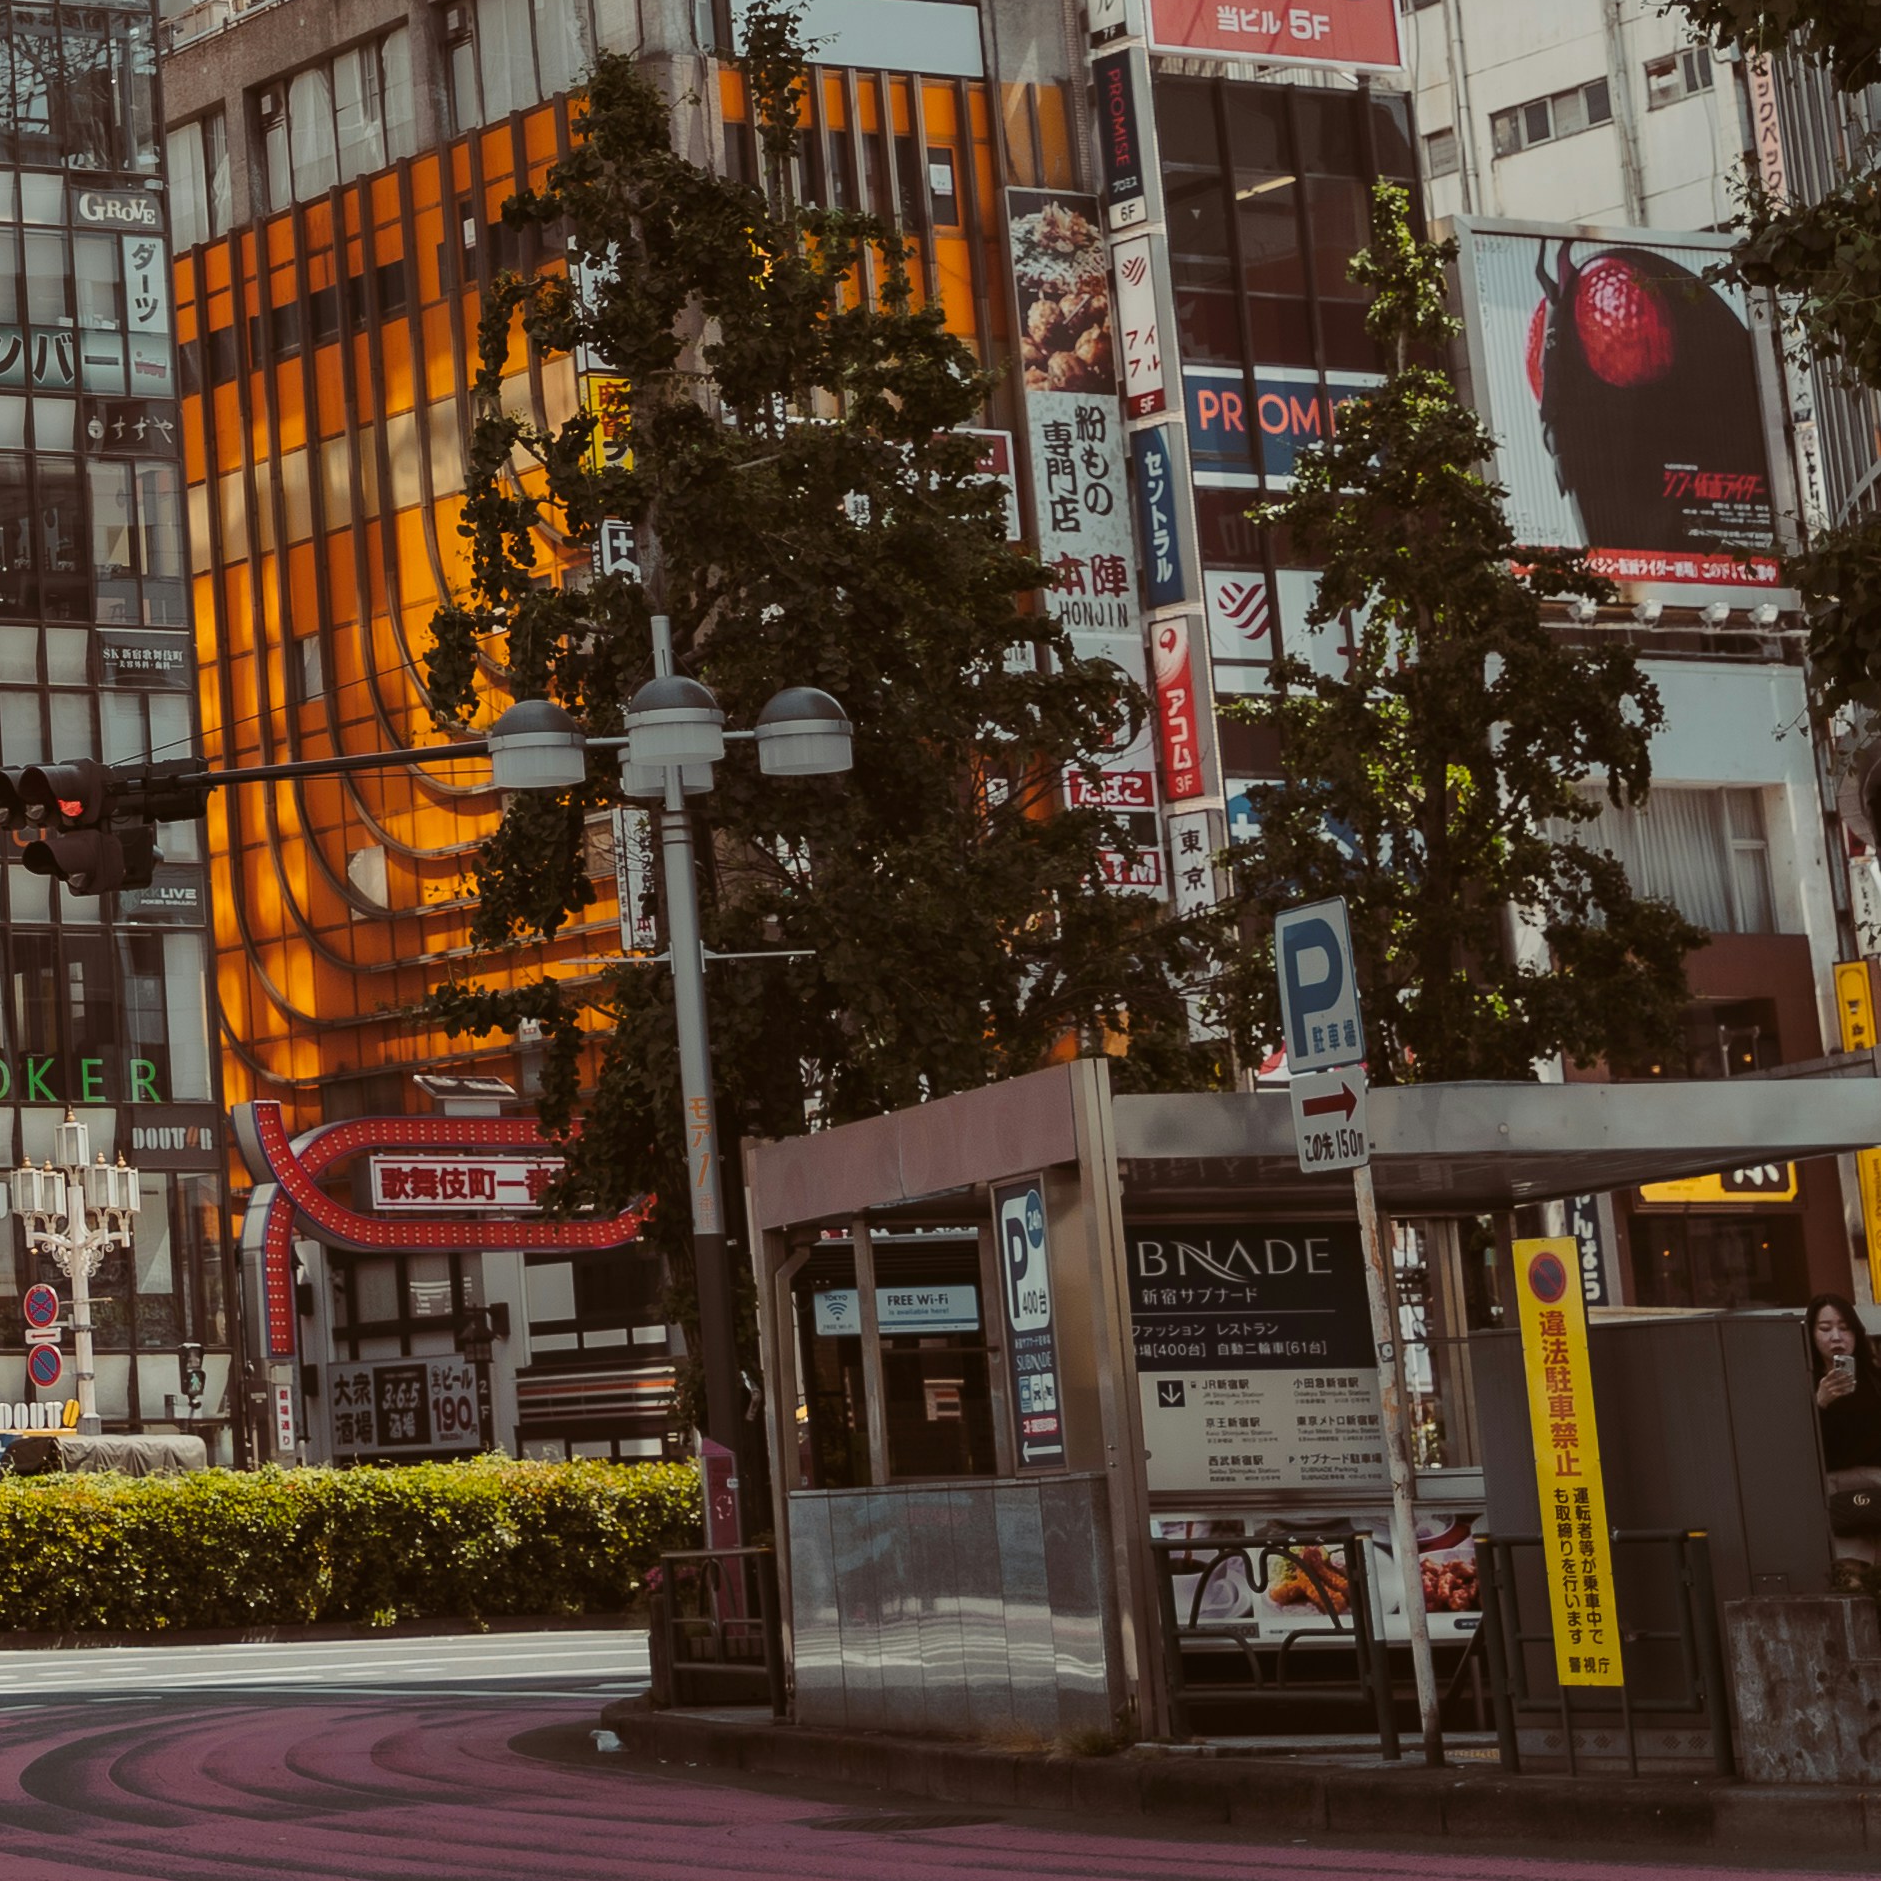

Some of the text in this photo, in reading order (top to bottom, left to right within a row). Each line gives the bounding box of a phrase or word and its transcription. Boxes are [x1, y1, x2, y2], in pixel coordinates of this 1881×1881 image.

[1216, 4, 1331, 42] 当ビル 5F
[1107, 68, 1132, 169] PROMISE
[78, 192, 156, 225] GROVE
[1120, 202, 1136, 225] 6F
[131, 243, 160, 323] ダーツ
[1139, 395, 1157, 415] 5F
[1042, 421, 1081, 534] 専門店
[1075, 404, 1114, 516] 粉もの
[1144, 450, 1174, 585] セントラル
[1049, 553, 1129, 599] 本陣
[1059, 600, 1129, 629] HONJIN
[1164, 688, 1194, 771] アコム
[1077, 776, 1147, 805] たばこ
[1174, 774, 1194, 794] 3F
[1282, 918, 1343, 1058] P
[132, 1126, 213, 1151] DOUTOR
[380, 1166, 561, 1201] 歌舞伎町一番
[1026, 1210, 1042, 1232] 24h
[1006, 1217, 1028, 1318] P
[1137, 1238, 1332, 1283] BNADE
[887, 1293, 949, 1307] FREE Wi-Fi
[1141, 1287, 1258, 1305] 新宿サブナード
[1217, 1322, 1279, 1336] レストラン
[1134, 1340, 1327, 1358] 場[400台] 自動二輪車[61台]
[1202, 1377, 1359, 1390] JR新宿駅 小田急新宿駅
[1539, 1310, 1583, 1477] 違法駐車禁止
[1554, 1487, 1583, 1645] も取締りを行います
[1573, 1487, 1604, 1645] 運転者等が乗車中で
[1568, 1656, 1610, 1675] 警視庁
